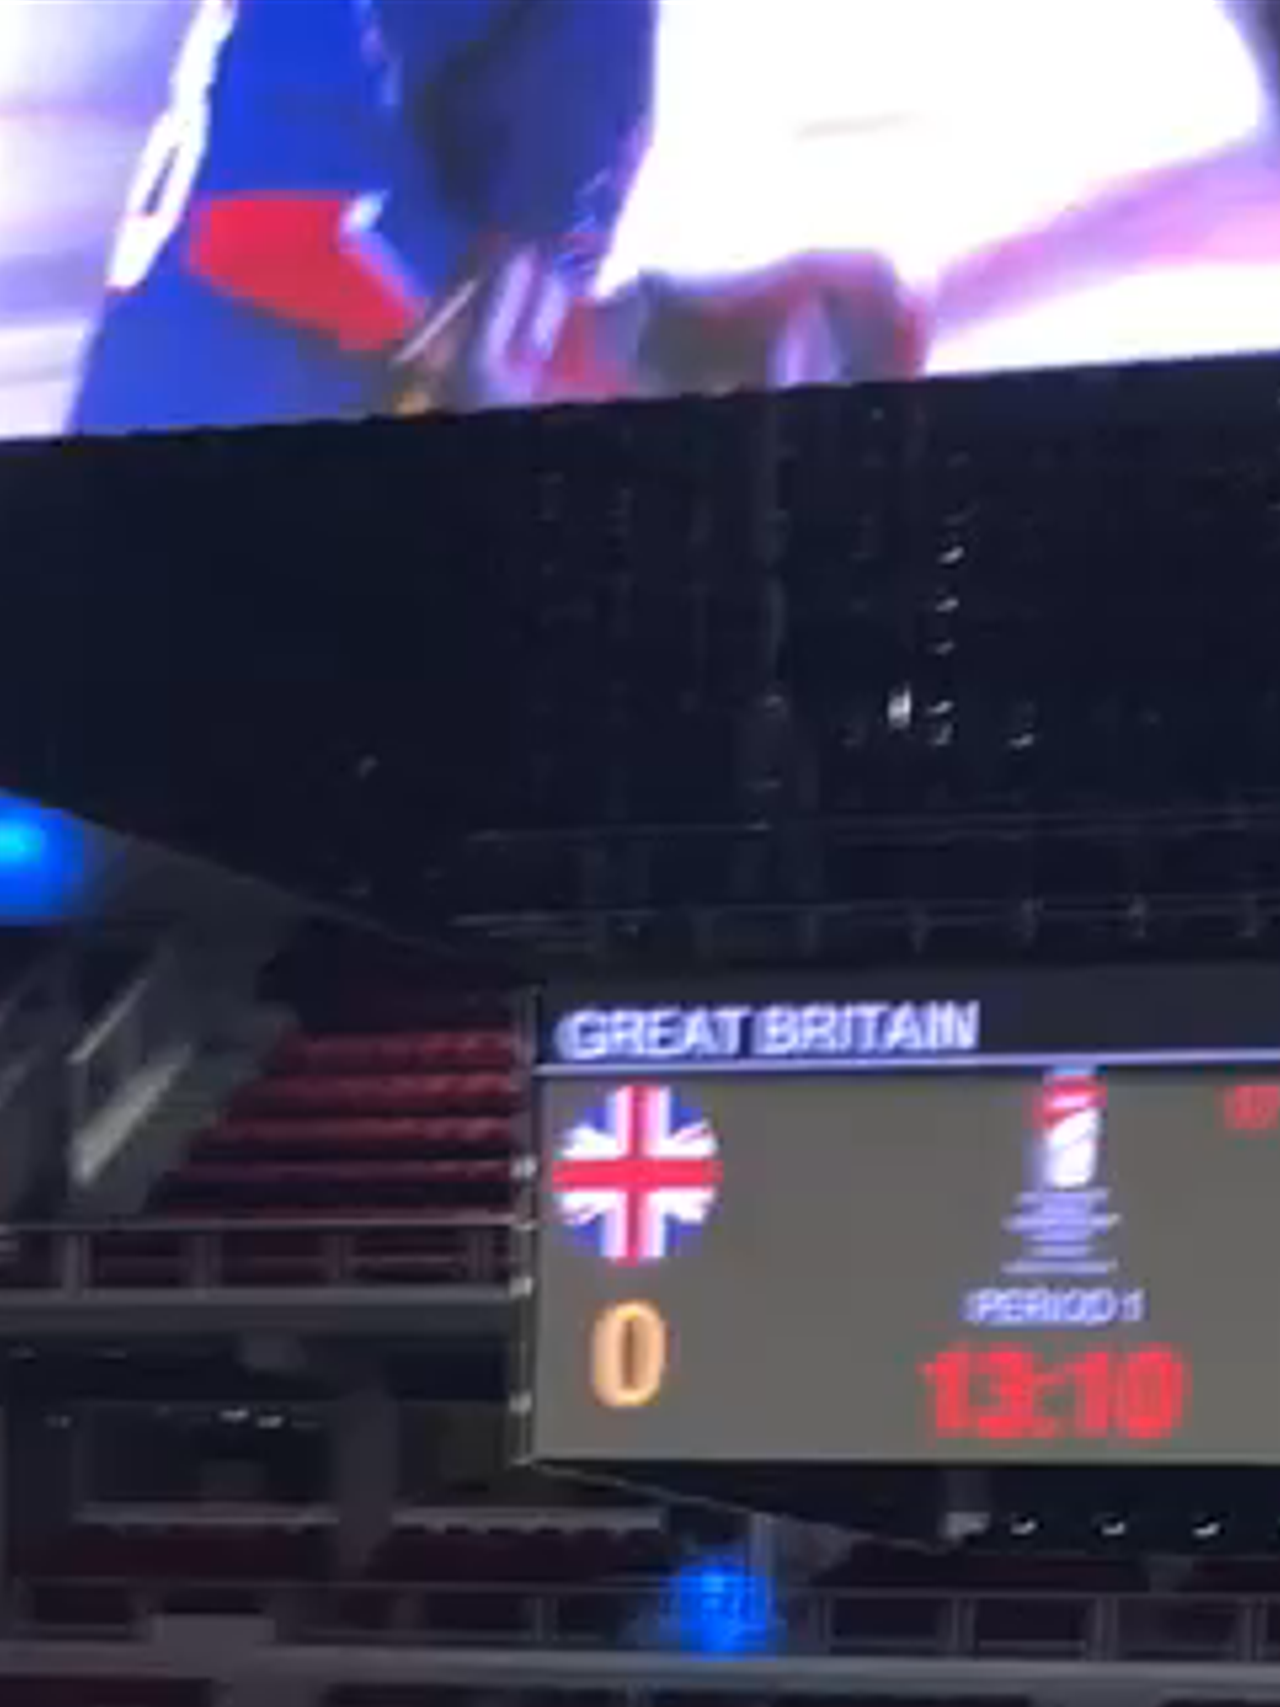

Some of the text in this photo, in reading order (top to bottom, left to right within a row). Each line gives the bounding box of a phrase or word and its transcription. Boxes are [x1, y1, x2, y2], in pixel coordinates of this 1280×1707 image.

[556, 1000, 982, 1060] GREAT BRITAIN
[967, 1288, 1114, 1326] PERIOD
[590, 1302, 668, 1408] 0
[923, 1345, 1190, 1440] 13:10
